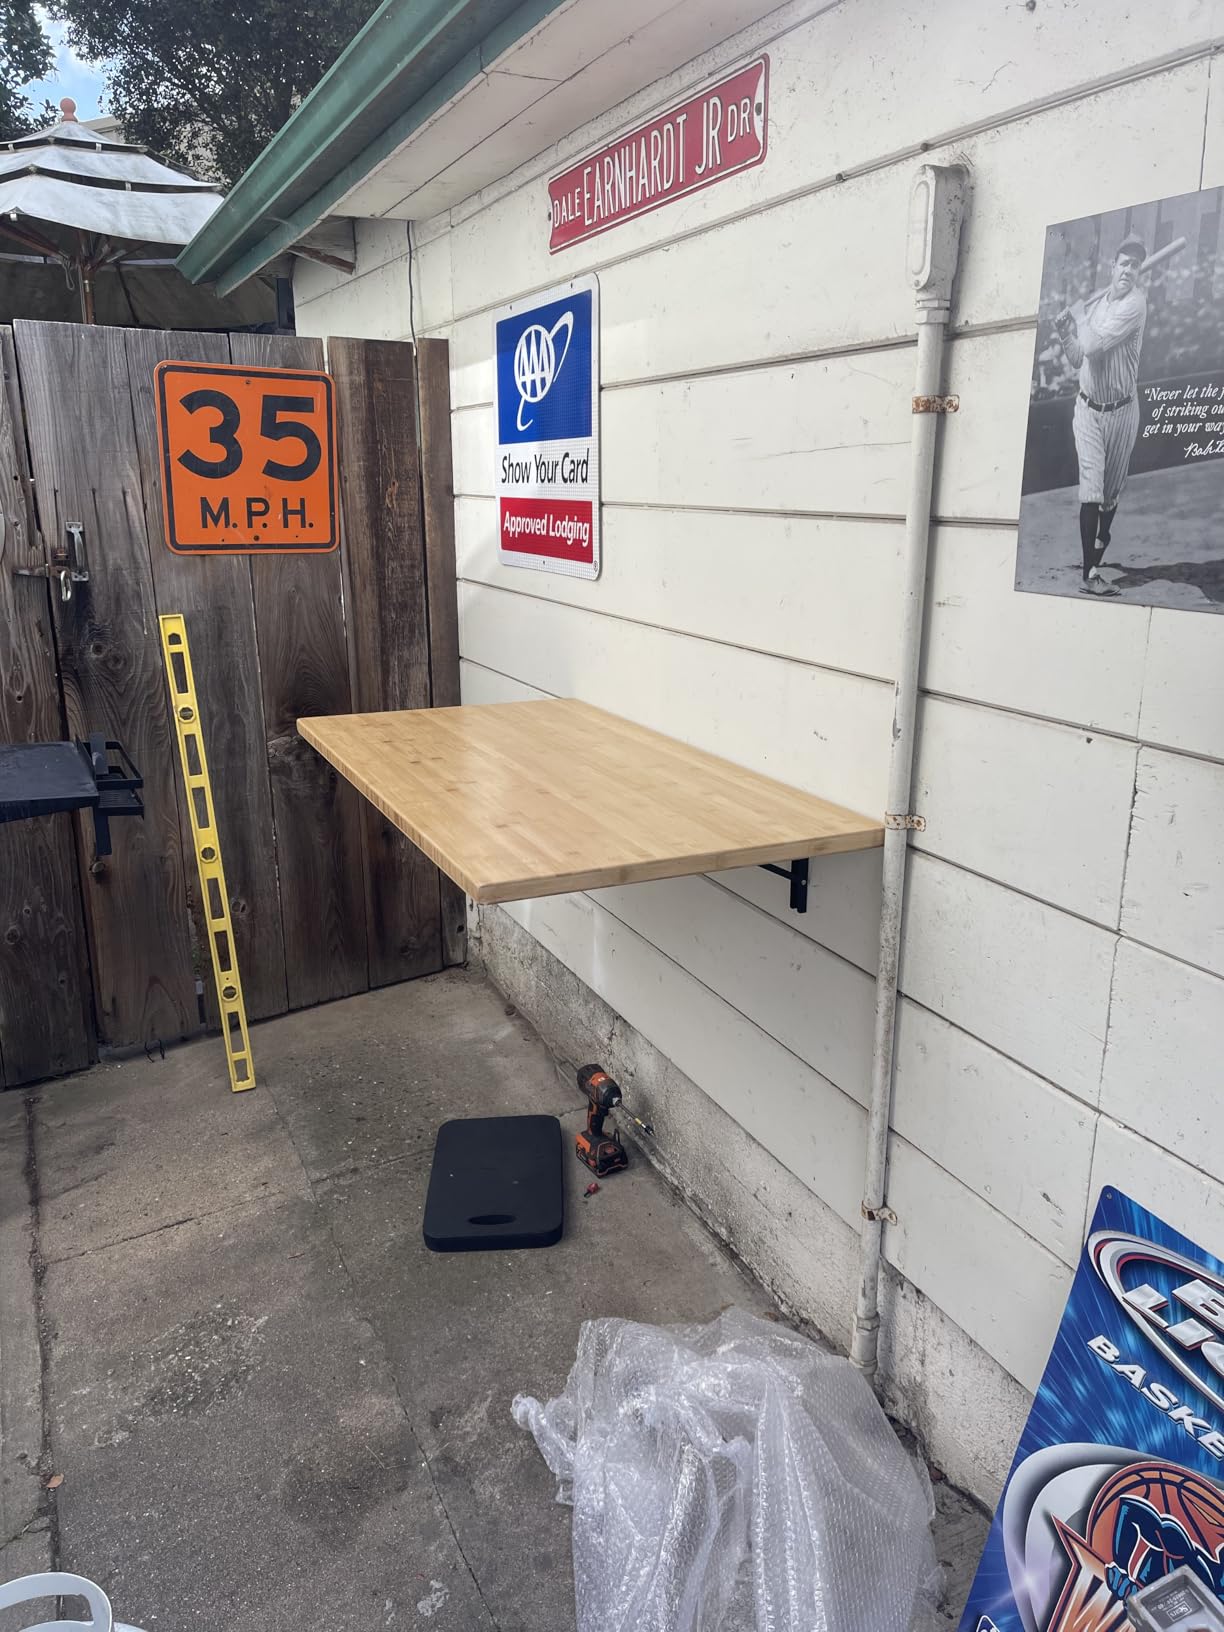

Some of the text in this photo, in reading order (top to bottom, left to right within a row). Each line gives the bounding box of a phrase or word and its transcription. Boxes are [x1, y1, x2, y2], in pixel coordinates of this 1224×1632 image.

[554, 96, 750, 228] DALE EARNHARDT JR DR
[515, 325, 554, 402] AAA
[1184, 385, 1198, 398] let
[1201, 384, 1218, 398] the
[1143, 424, 1160, 437] get
[1162, 420, 1173, 433] in
[1174, 423, 1202, 436] your
[1152, 404, 1165, 420] of
[1165, 402, 1209, 418] striking
[177, 388, 322, 482] 35
[501, 447, 590, 484] Show Your Card
[200, 496, 314, 529] M.P.H.
[503, 511, 590, 548] Approved Lodging
[1087, 1333, 1224, 1462] BASKE
[1169, 1604, 1189, 1617] Sears
